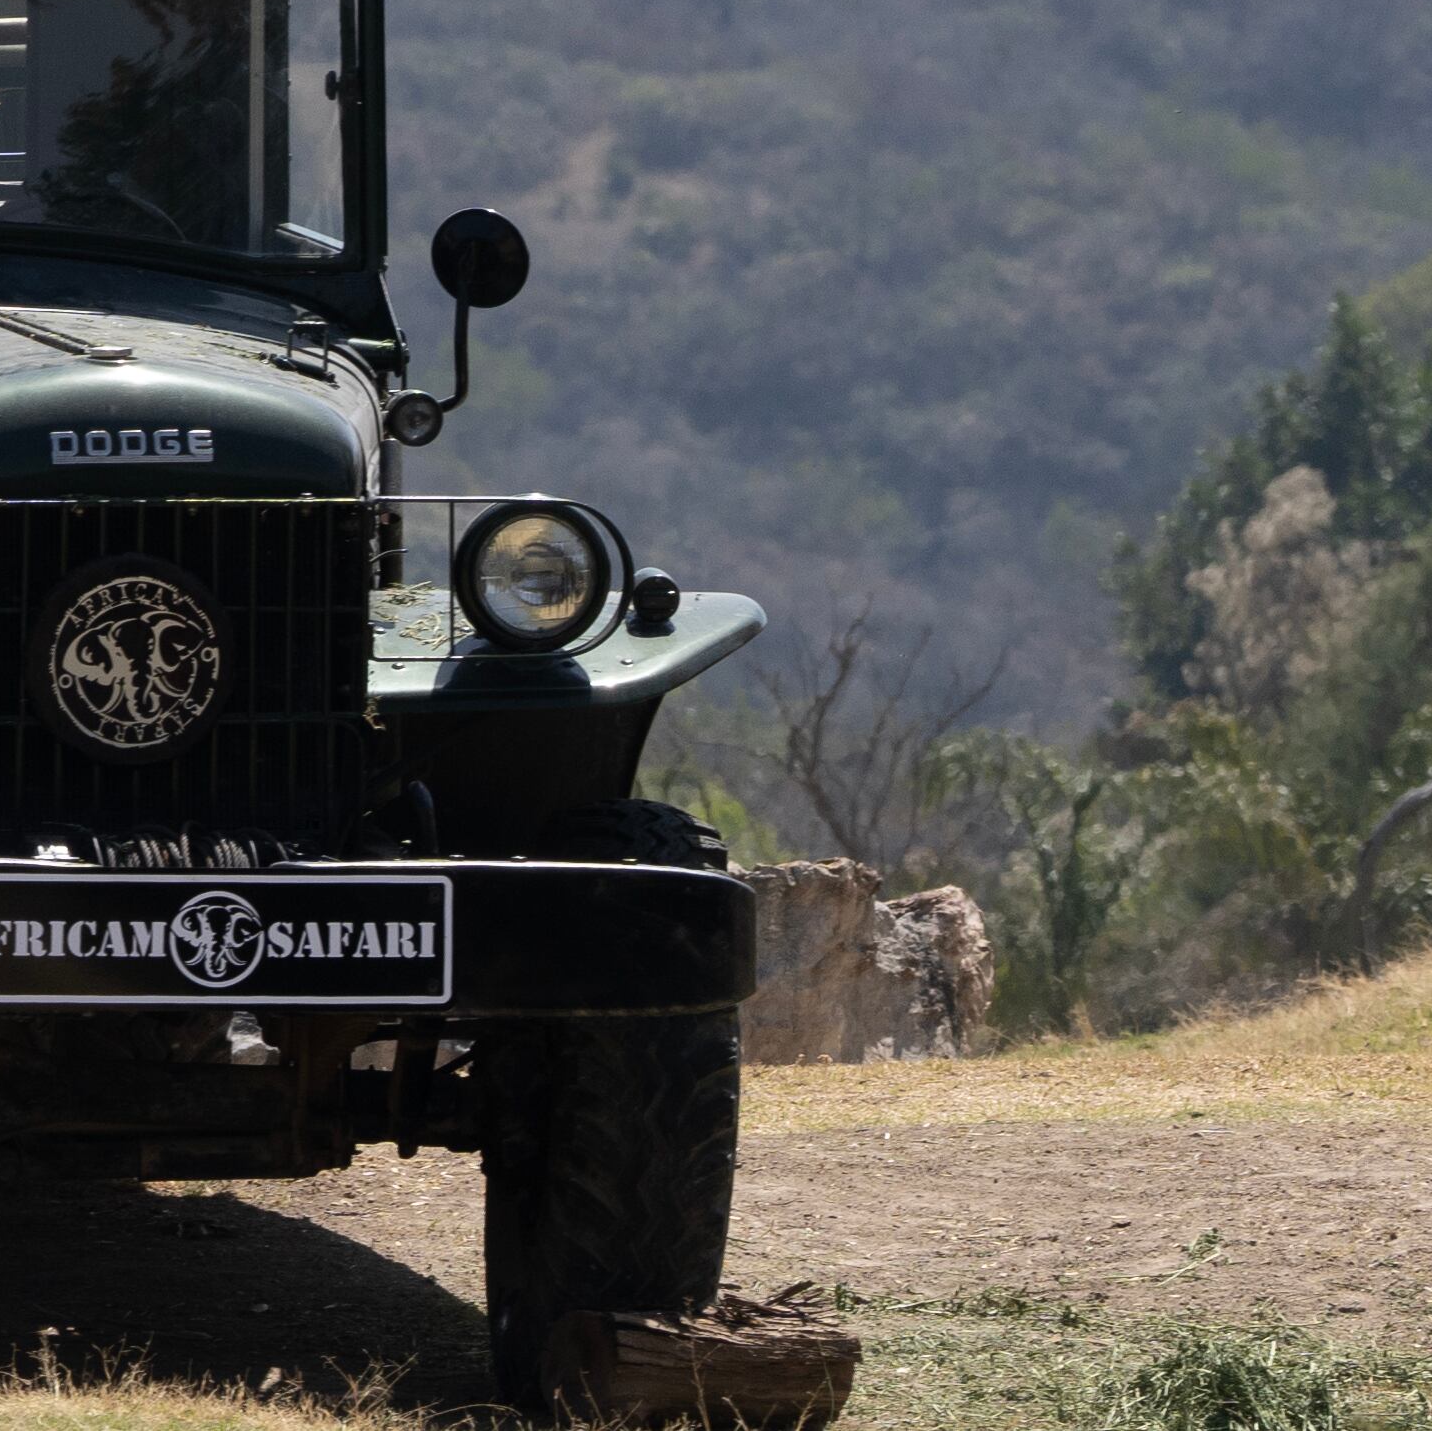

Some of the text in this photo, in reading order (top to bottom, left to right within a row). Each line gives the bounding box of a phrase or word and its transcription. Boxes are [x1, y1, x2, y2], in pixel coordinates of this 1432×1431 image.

[49, 428, 214, 456] DODGE
[93, 697, 201, 743] SAFARI
[266, 920, 436, 959] SAFARI
